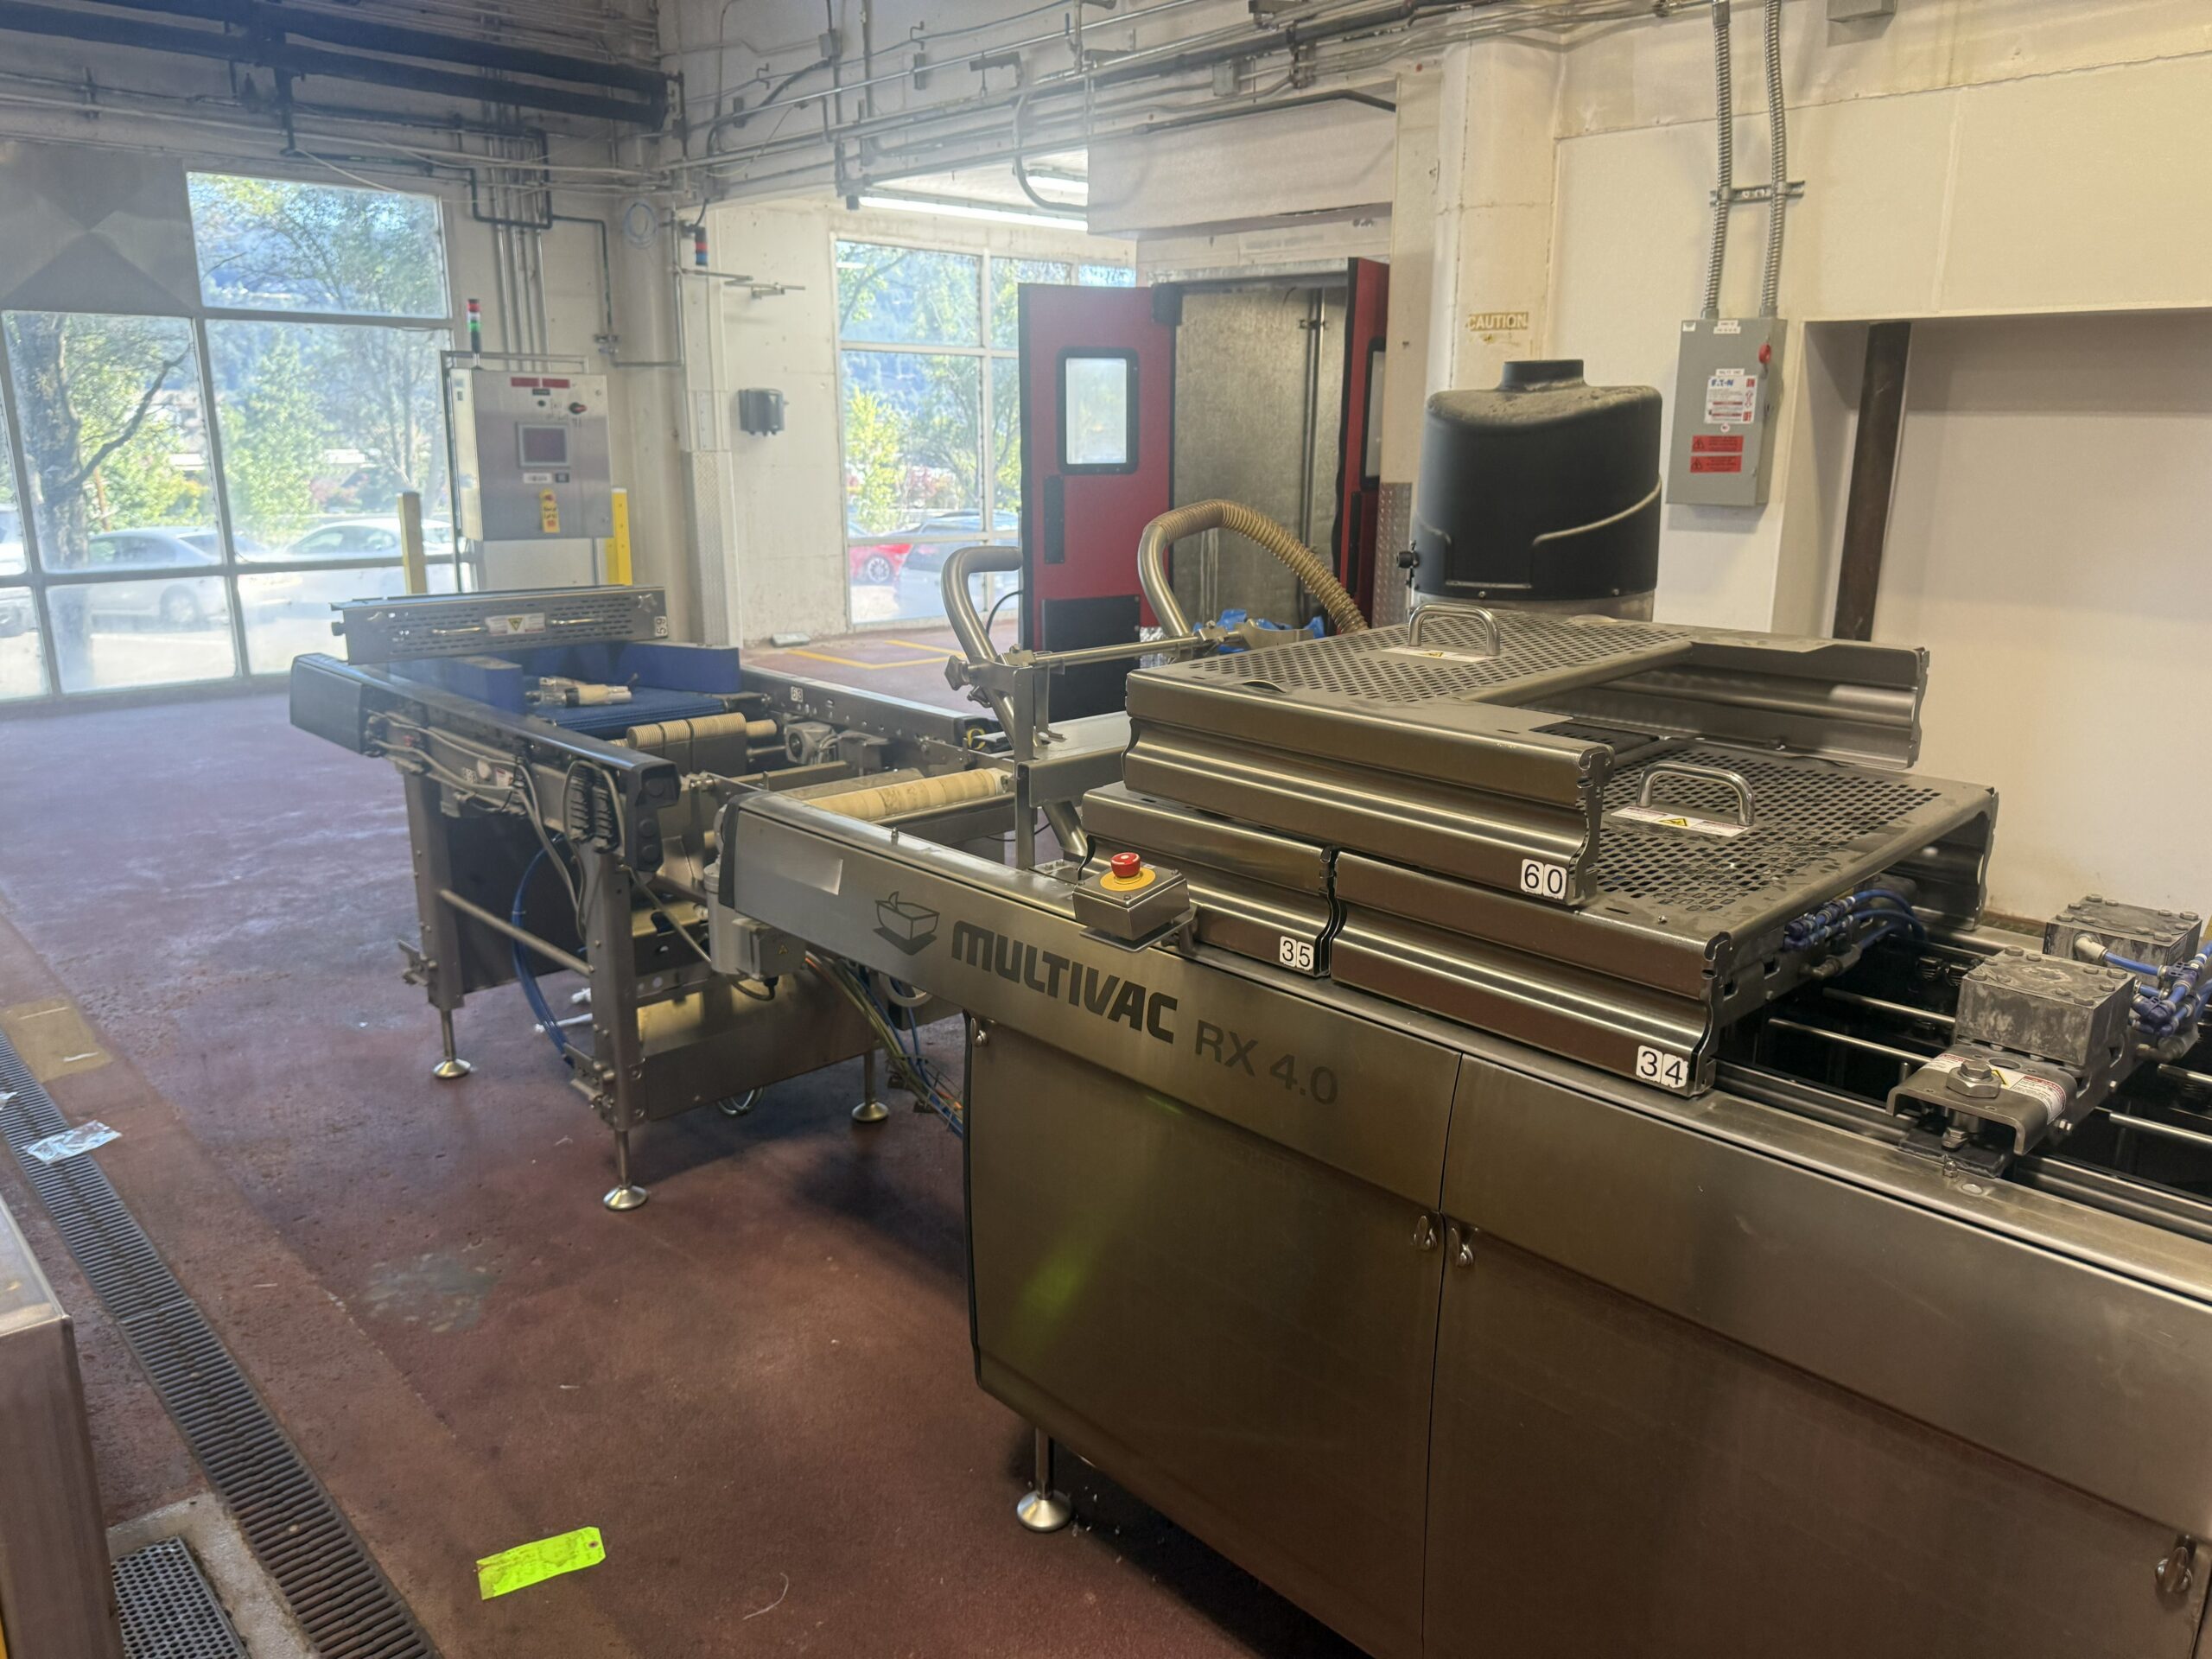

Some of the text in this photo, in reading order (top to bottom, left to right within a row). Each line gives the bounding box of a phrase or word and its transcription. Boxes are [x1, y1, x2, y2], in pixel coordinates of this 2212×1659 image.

[1468, 313, 1528, 330] CAUTION
[1524, 863, 1563, 894] 60
[1281, 939, 1311, 968] 35
[951, 919, 1338, 1105] MULTIVAC RX 4.0
[1640, 1051, 1682, 1085] 34
